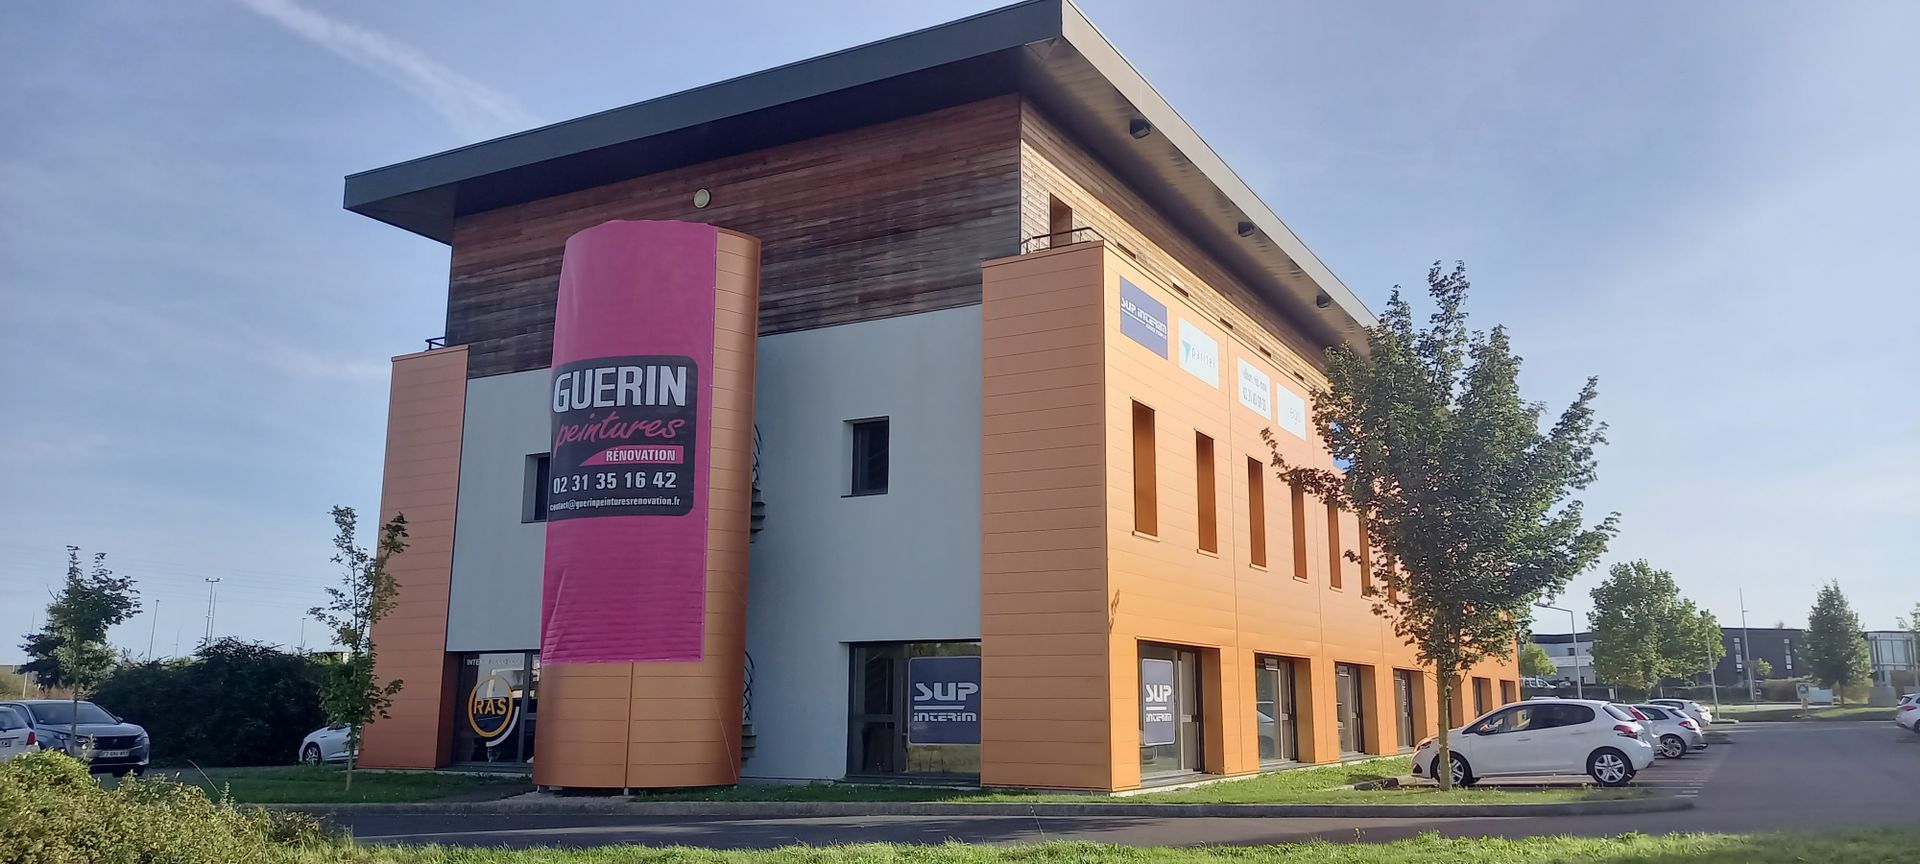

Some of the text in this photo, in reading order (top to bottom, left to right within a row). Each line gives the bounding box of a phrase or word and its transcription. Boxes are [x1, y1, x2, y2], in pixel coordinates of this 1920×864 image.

[553, 365, 687, 413] GUERIN
[554, 411, 686, 459] peintures
[606, 447, 676, 462] RÉNOVATION
[553, 471, 677, 494] 02 31 35 16 42
[549, 496, 681, 511] contact@guerinpeinturesrenovation.fr
[914, 682, 979, 701] SUP
[1145, 684, 1172, 703] SUP
[473, 698, 507, 715] RAS
